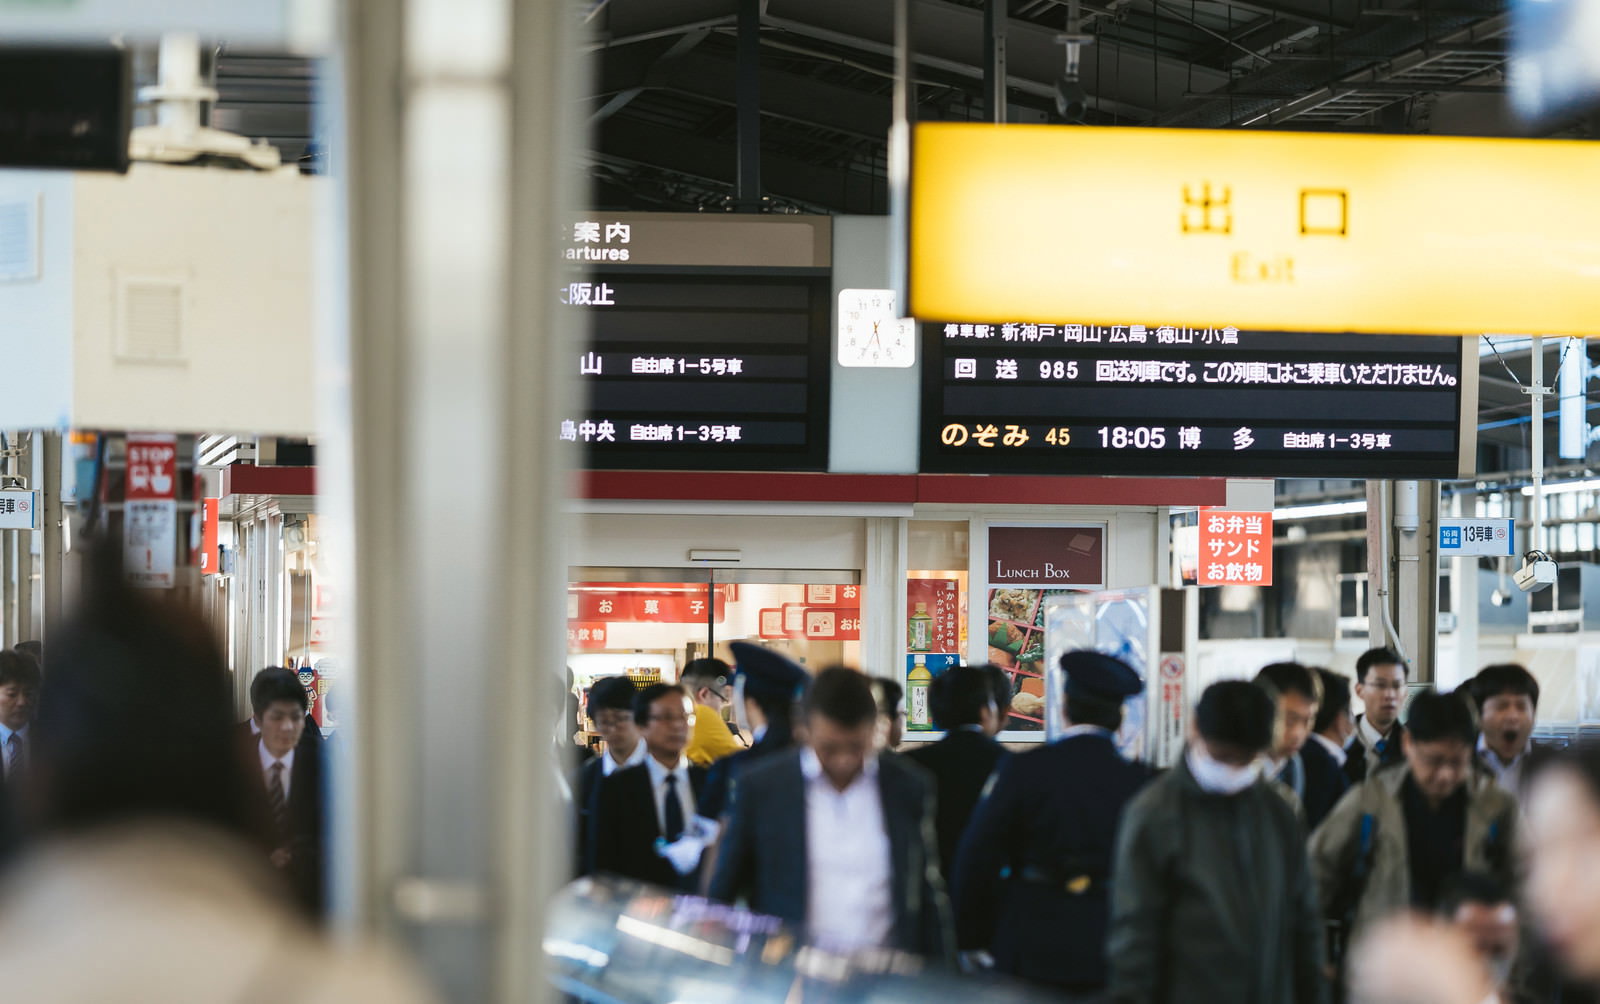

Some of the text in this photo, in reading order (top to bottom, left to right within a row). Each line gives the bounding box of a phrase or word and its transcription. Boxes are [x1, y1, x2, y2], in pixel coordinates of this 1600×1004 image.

[1181, 180, 1348, 237] 出口
[562, 246, 629, 261] artures
[1231, 251, 1294, 284] Exit
[580, 351, 602, 375] 山
[1039, 361, 1079, 379] 985
[941, 423, 1029, 447] のぞみ
[1045, 427, 1070, 445] 45
[1098, 426, 1166, 448] 18:05
[129, 446, 173, 463] STOP
[1207, 515, 1263, 535] お弁当
[1463, 526, 1493, 542] 13号車
[1207, 539, 1260, 558] サンド
[1207, 562, 1263, 581] お飲物
[843, 586, 856, 598] お
